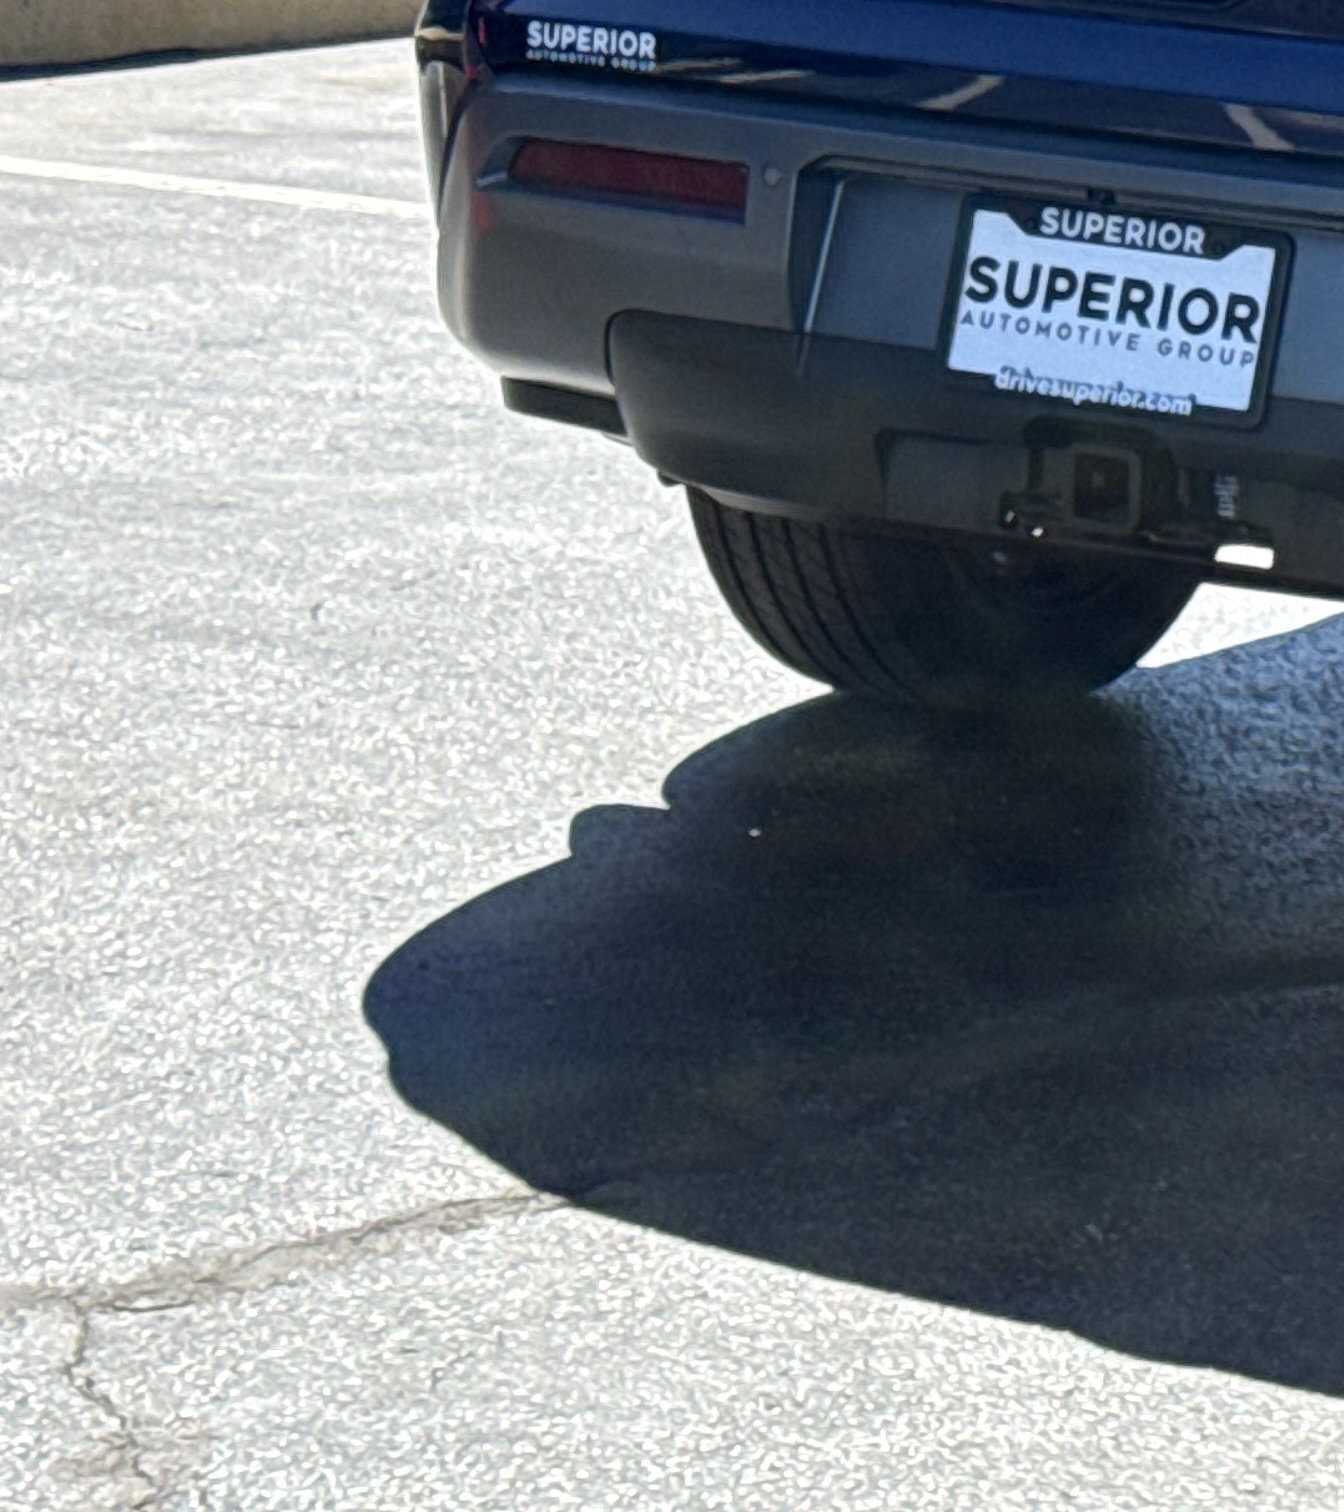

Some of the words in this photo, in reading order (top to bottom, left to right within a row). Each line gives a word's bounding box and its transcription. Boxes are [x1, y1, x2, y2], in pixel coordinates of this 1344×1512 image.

[526, 20, 657, 59] SUPERIOR
[1039, 206, 1206, 255] SUPERIOR
[964, 256, 1259, 344] SUPERIOR
[960, 309, 1141, 352] AUTOMOTIVE
[1156, 338, 1255, 369] GROUP
[993, 368, 1193, 416] drivesuperior.com
